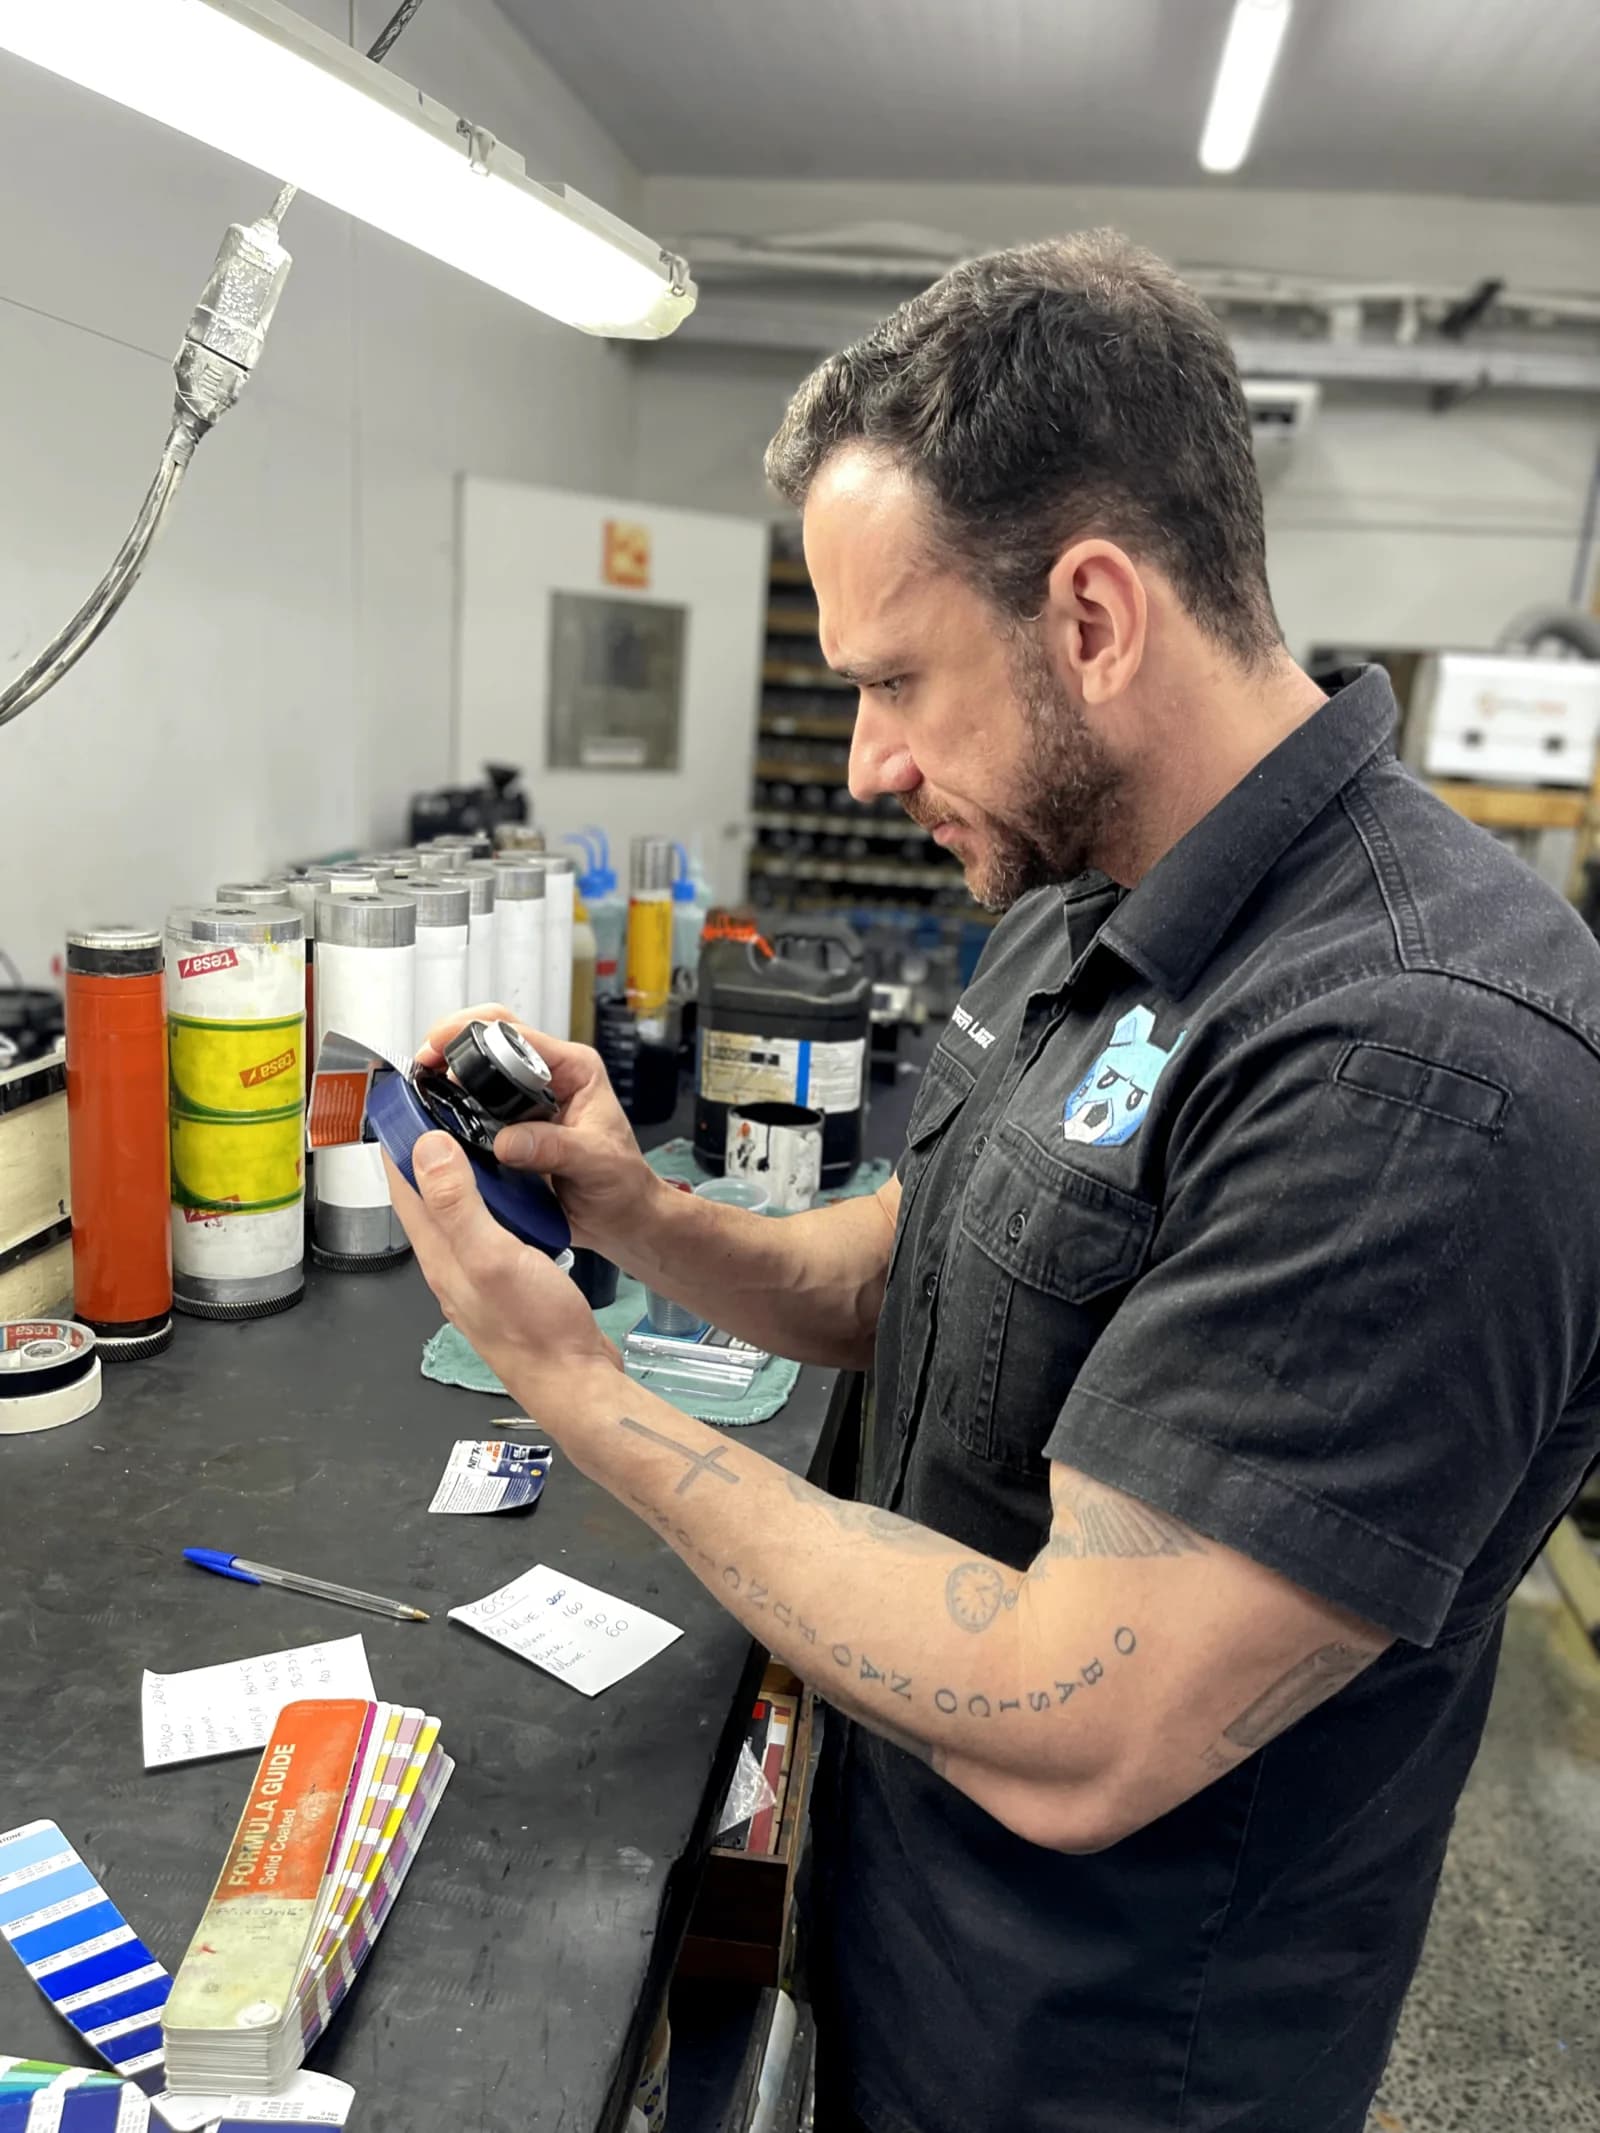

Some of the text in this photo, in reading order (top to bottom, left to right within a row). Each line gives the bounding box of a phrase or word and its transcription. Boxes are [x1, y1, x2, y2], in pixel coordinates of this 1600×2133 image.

[193, 952, 234, 973] tesa
[260, 1053, 294, 1079] tesa
[15, 1324, 54, 1337] tesa
[228, 1800, 278, 1886] FORMULA
[261, 1743, 296, 1796] GUIDE
[258, 1808, 297, 1885] Solid Coated
